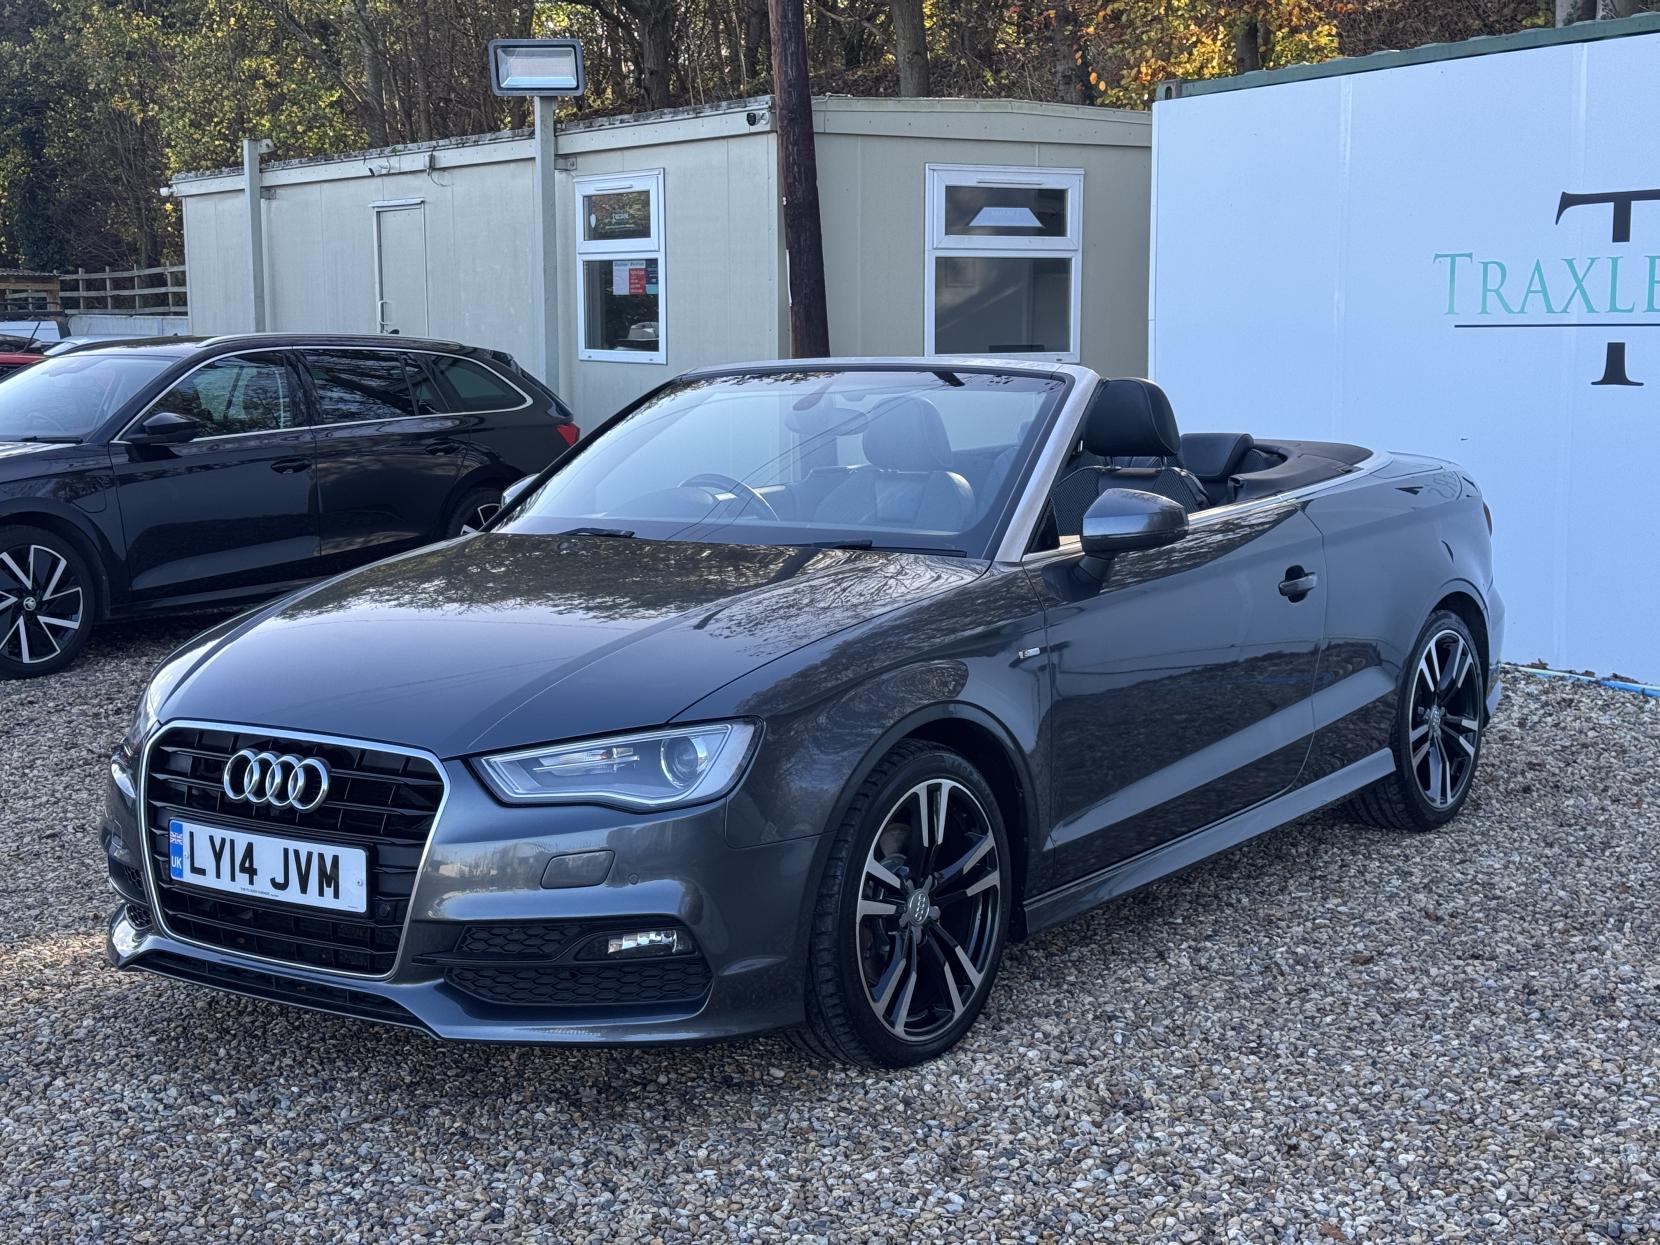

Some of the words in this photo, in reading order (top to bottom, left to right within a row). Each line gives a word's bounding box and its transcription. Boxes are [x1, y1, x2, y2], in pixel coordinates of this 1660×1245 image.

[171, 855, 182, 870] UK
[189, 830, 258, 886] LY14
[269, 846, 340, 900] JVM
